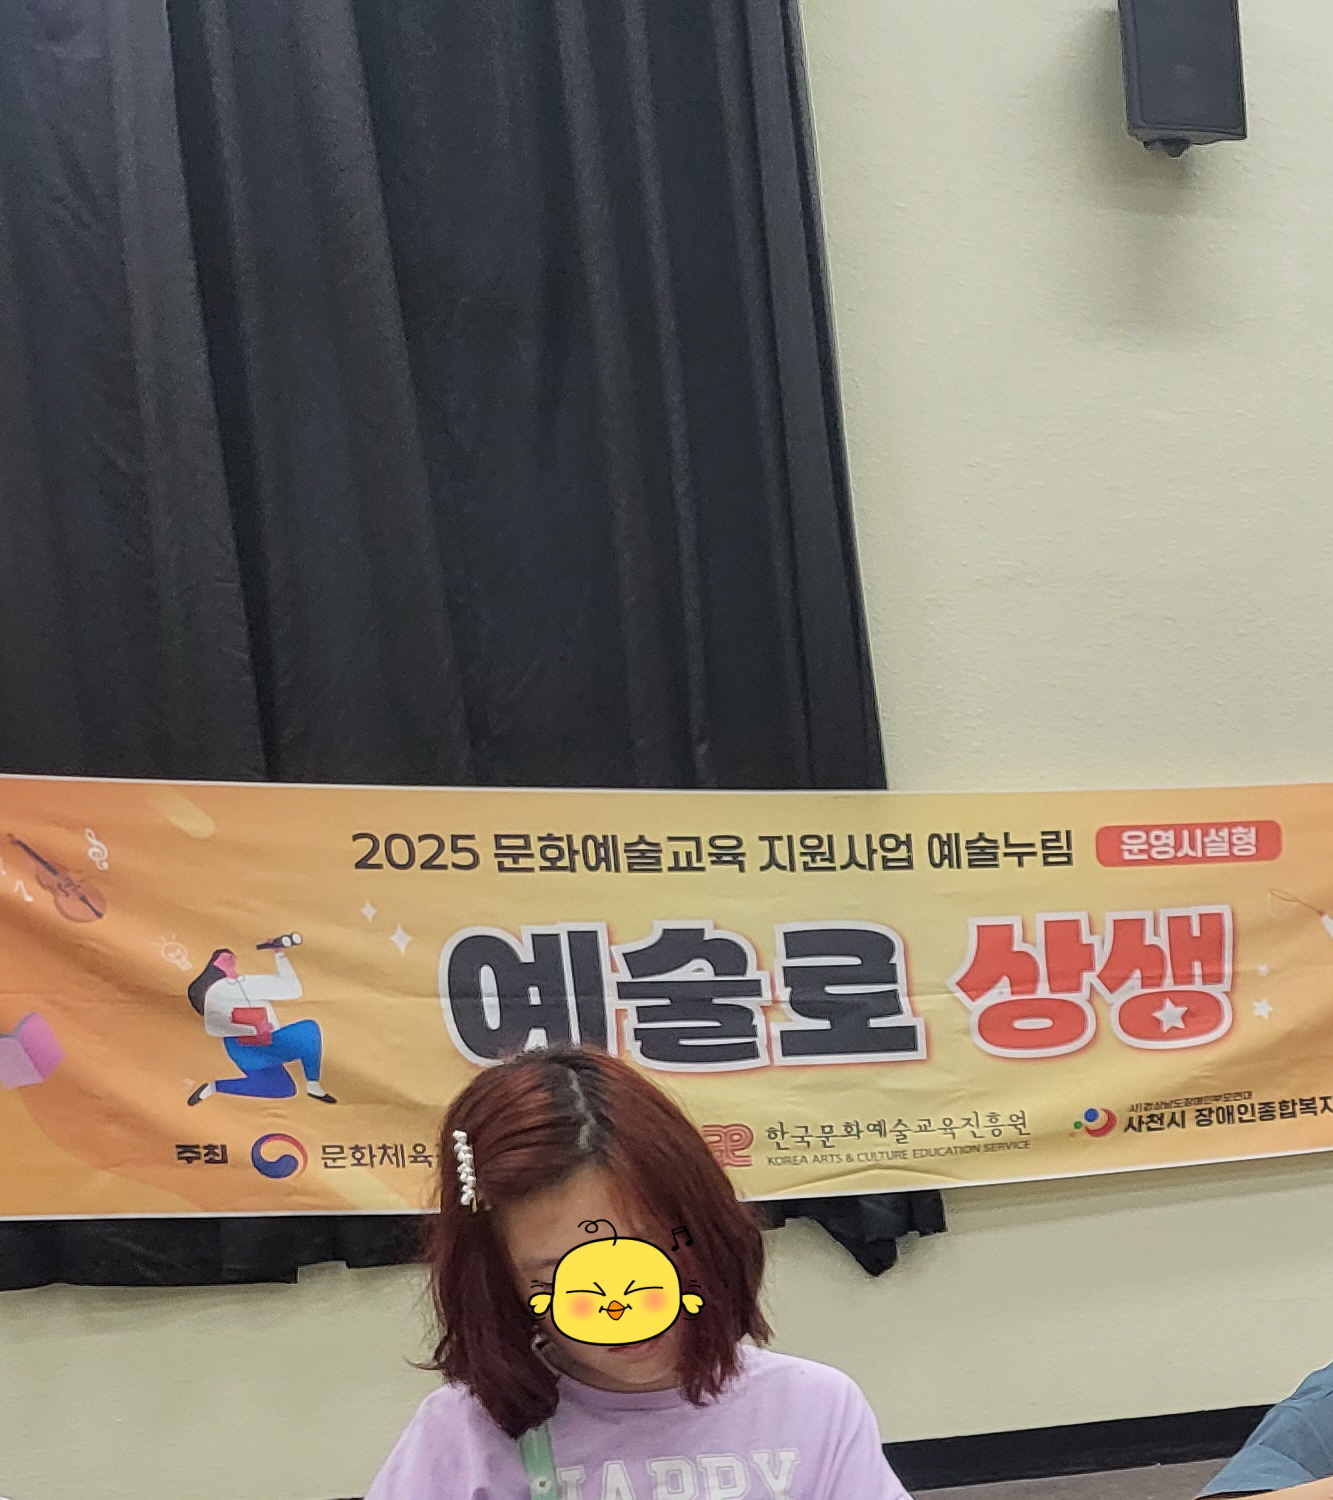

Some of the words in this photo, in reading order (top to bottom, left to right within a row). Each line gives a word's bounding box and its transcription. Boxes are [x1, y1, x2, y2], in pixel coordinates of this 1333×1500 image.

[351, 833, 481, 871] 2025
[492, 832, 747, 874] 문화예술교육
[758, 830, 914, 873] 지원사업
[927, 829, 1074, 870] 예술누림
[1119, 825, 1259, 861] 운영시설형
[442, 923, 923, 1068] 예술로
[949, 907, 1237, 1056] 상생
[765, 1109, 1032, 1151] 한국문화예술교육진흥원
[1123, 1109, 1187, 1134] 사천시
[175, 1142, 229, 1166] 주최
[320, 1141, 442, 1170] 문화체육
[767, 1155, 809, 1167] KOREA
[811, 1152, 843, 1165] ARTS
[845, 1152, 855, 1163] &
[857, 1149, 909, 1163] CULTURE
[912, 1143, 981, 1160] EDUCATION
[983, 1140, 1031, 1154] SERVICE
